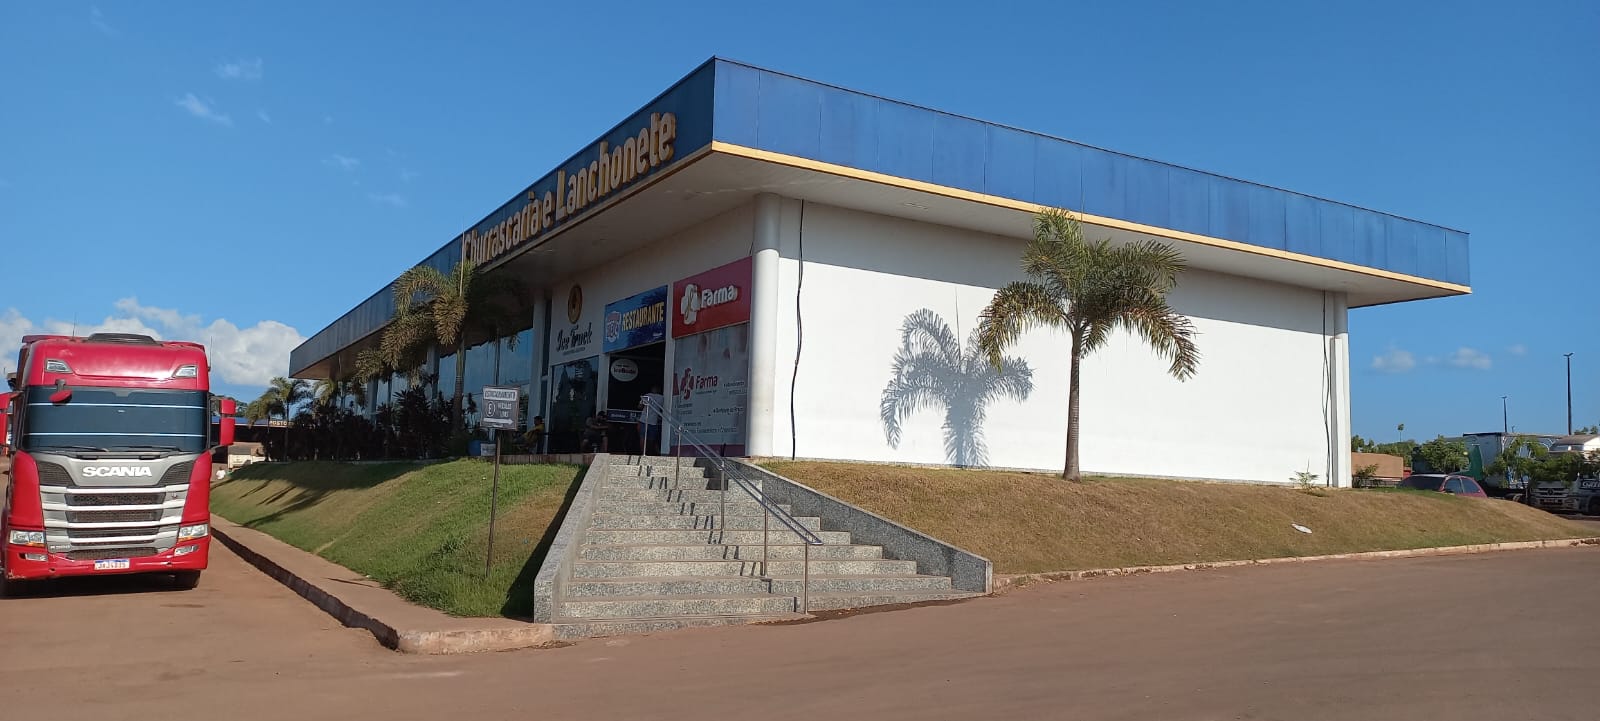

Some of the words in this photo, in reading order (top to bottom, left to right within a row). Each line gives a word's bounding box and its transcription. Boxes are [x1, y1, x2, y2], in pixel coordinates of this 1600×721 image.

[462, 191, 542, 267] Churrascaria
[542, 189, 555, 229] e
[555, 111, 677, 221] Lanchonete
[700, 285, 738, 309] Farma
[622, 301, 665, 332] RESTAURANTE
[570, 322, 593, 347] Truck
[695, 375, 718, 389] Farma
[82, 466, 152, 477] SCANIA
